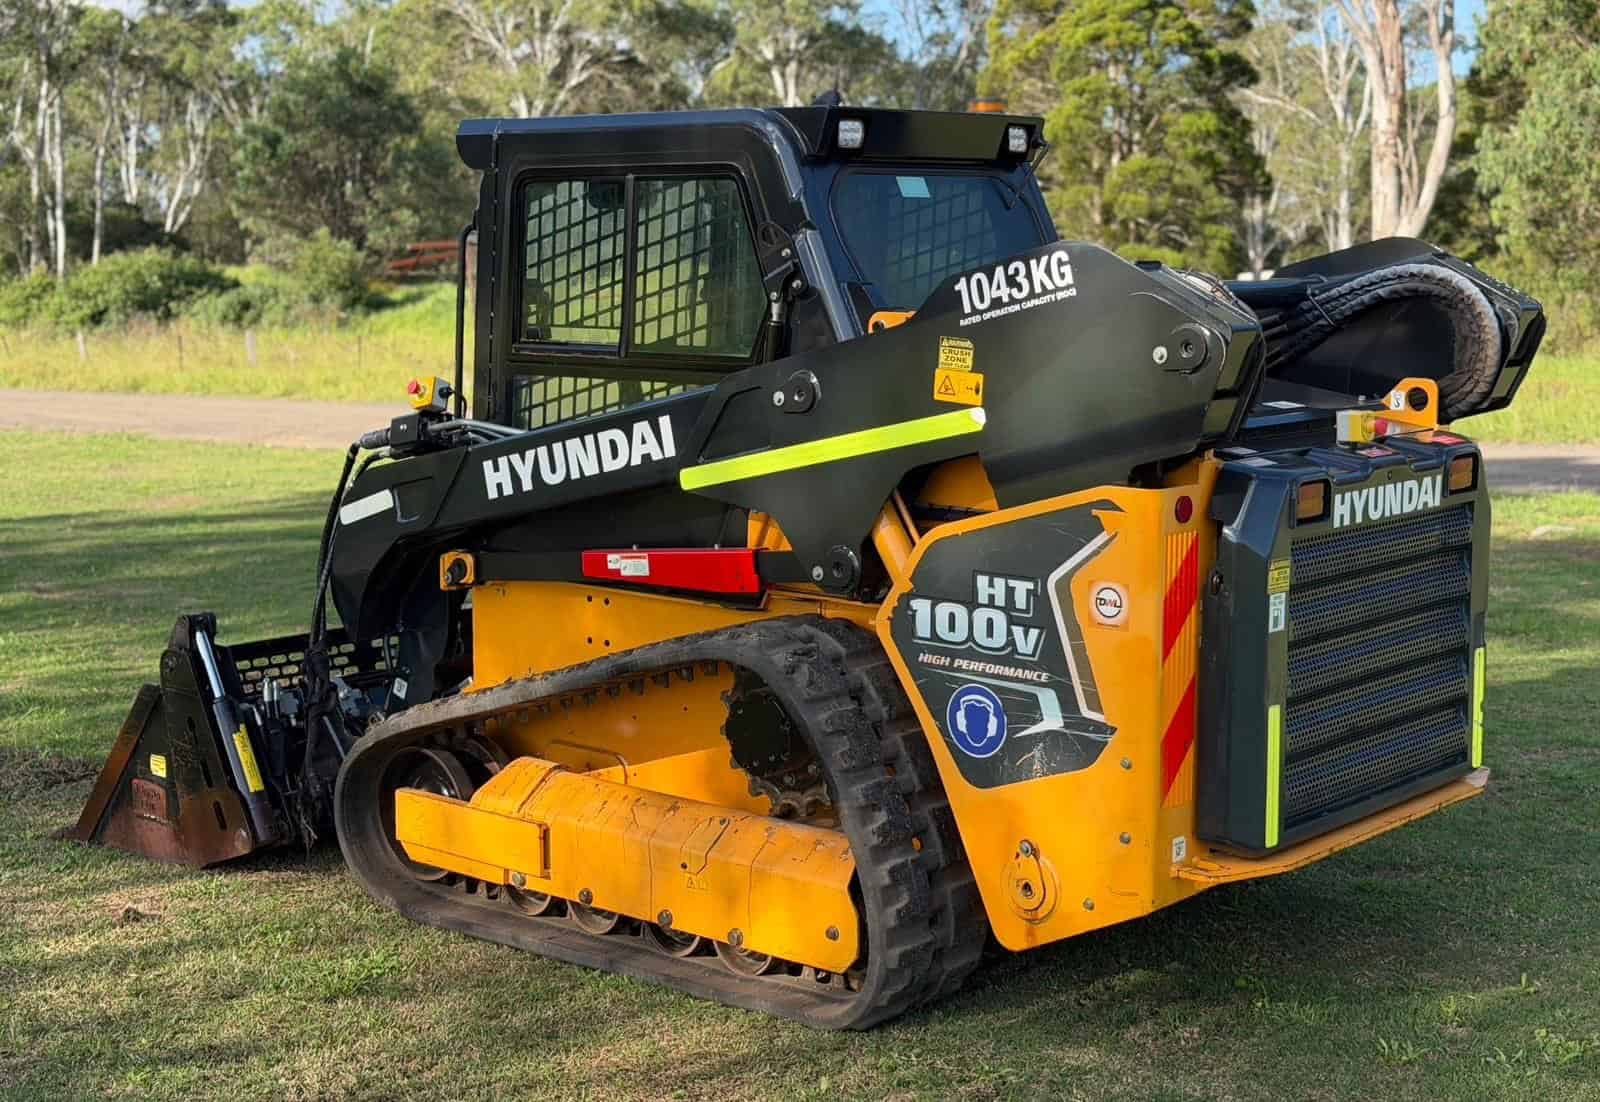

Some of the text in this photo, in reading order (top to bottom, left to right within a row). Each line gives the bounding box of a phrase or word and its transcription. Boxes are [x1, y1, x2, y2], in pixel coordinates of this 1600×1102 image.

[954, 250, 1074, 314] 1043 KG
[960, 314, 981, 326] RATED
[982, 303, 1021, 321] OPERATION
[1021, 293, 1057, 310] CAPACITY
[942, 348, 971, 357] CRUSH
[944, 355, 968, 364] ZONE
[482, 414, 676, 500] HYUNDAI
[1333, 474, 1442, 528] HYUNDAI
[976, 574, 1035, 610] HT
[918, 652, 1050, 683] HIGH PERFORMANCE
